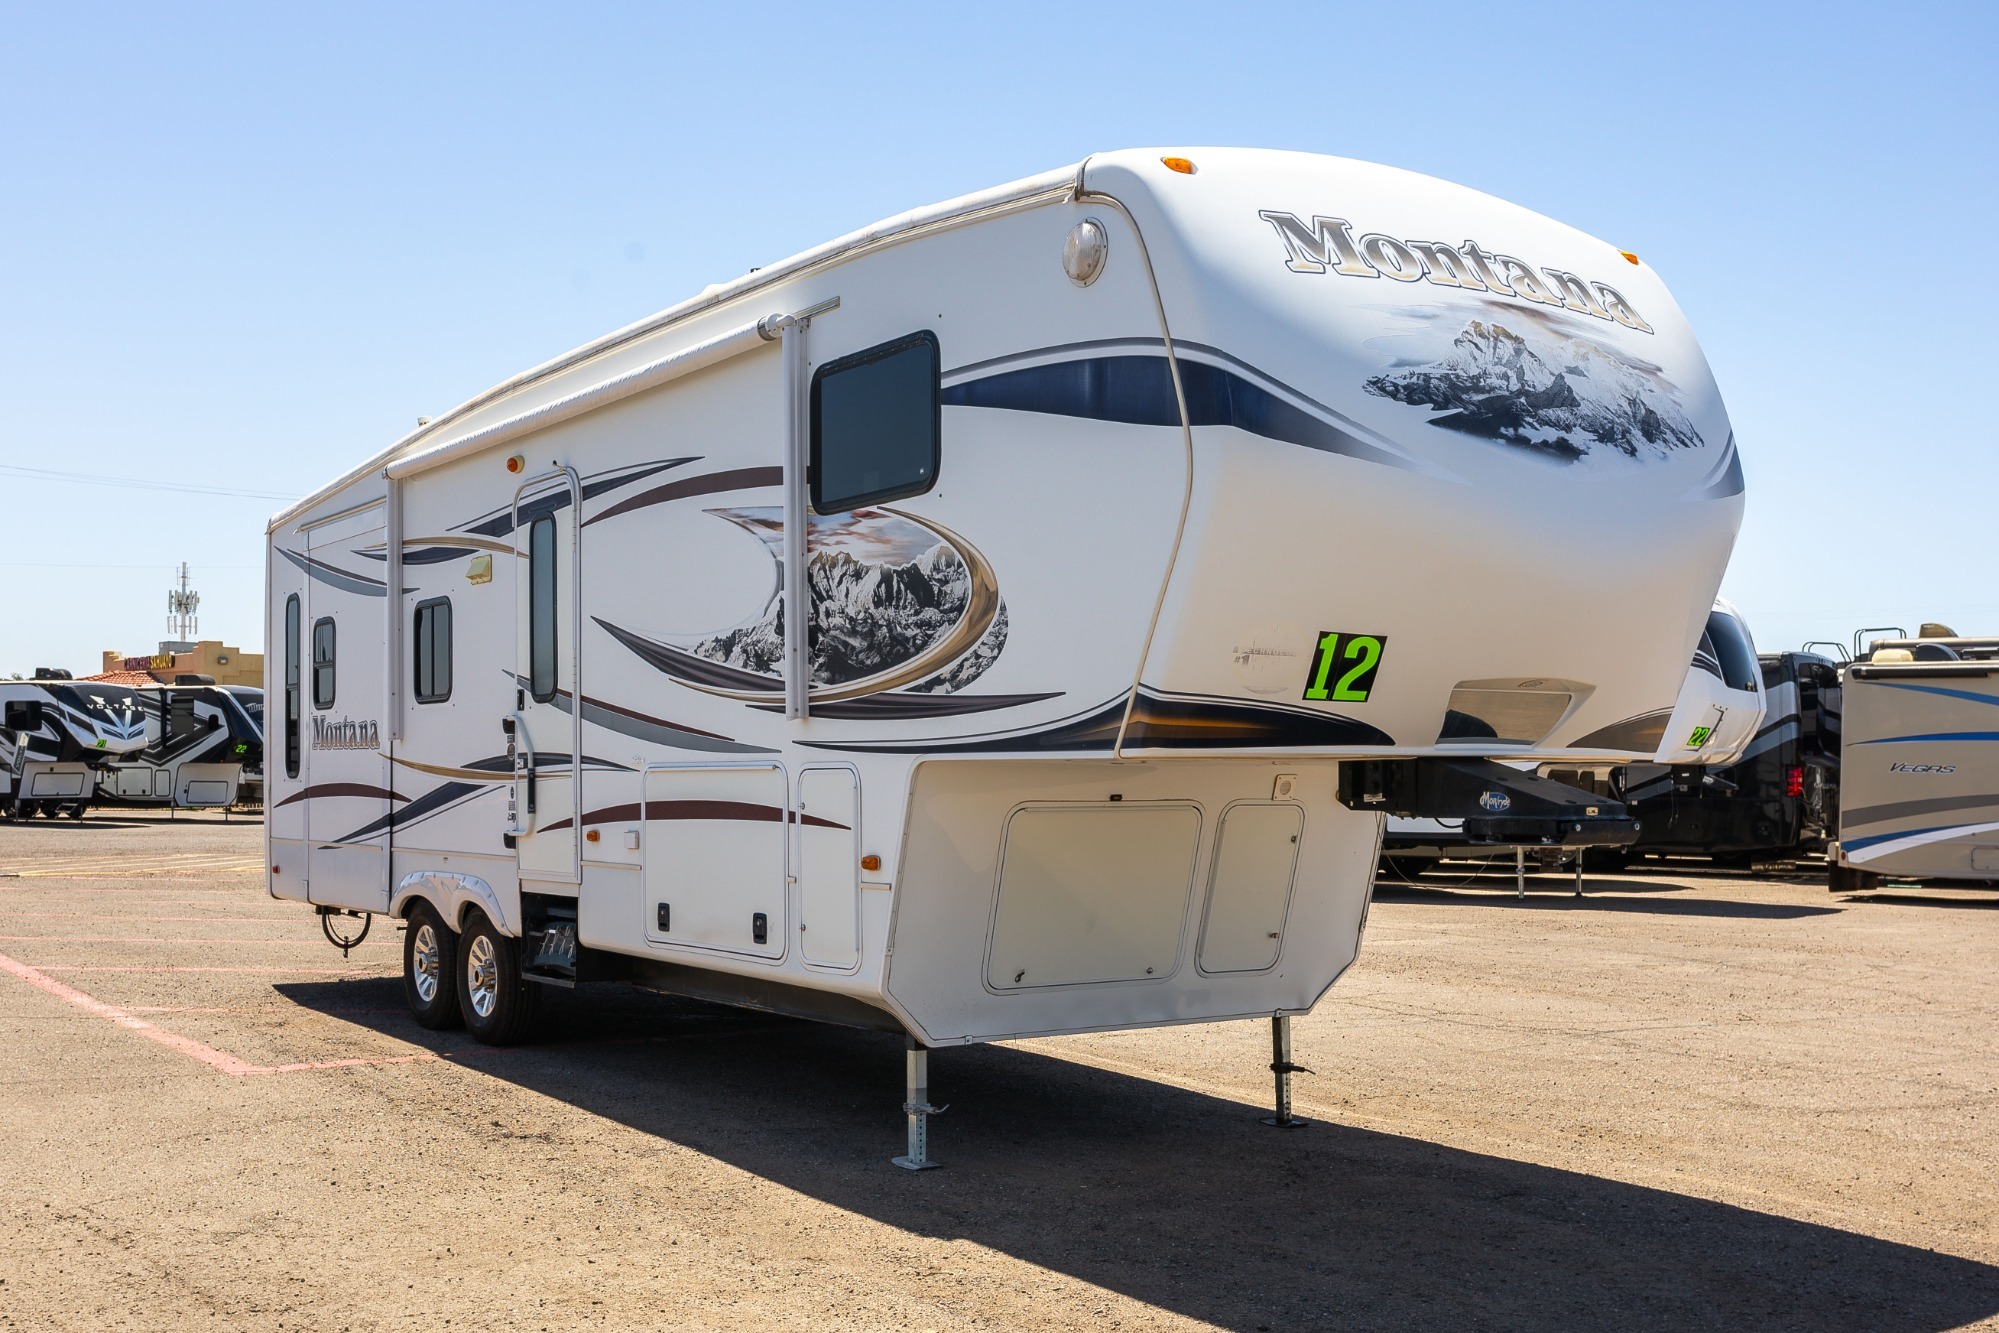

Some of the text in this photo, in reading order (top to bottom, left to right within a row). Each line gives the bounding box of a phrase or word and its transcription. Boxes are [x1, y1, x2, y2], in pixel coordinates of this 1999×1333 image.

[1258, 209, 1654, 335] Montana
[1306, 633, 1381, 700] 12
[87, 704, 145, 712] VOLTAGE
[312, 714, 381, 750] Montana
[1688, 727, 1710, 746] 22
[97, 739, 107, 749] 21
[235, 744, 247, 753] 22
[1889, 762, 1957, 774] VEGAS
